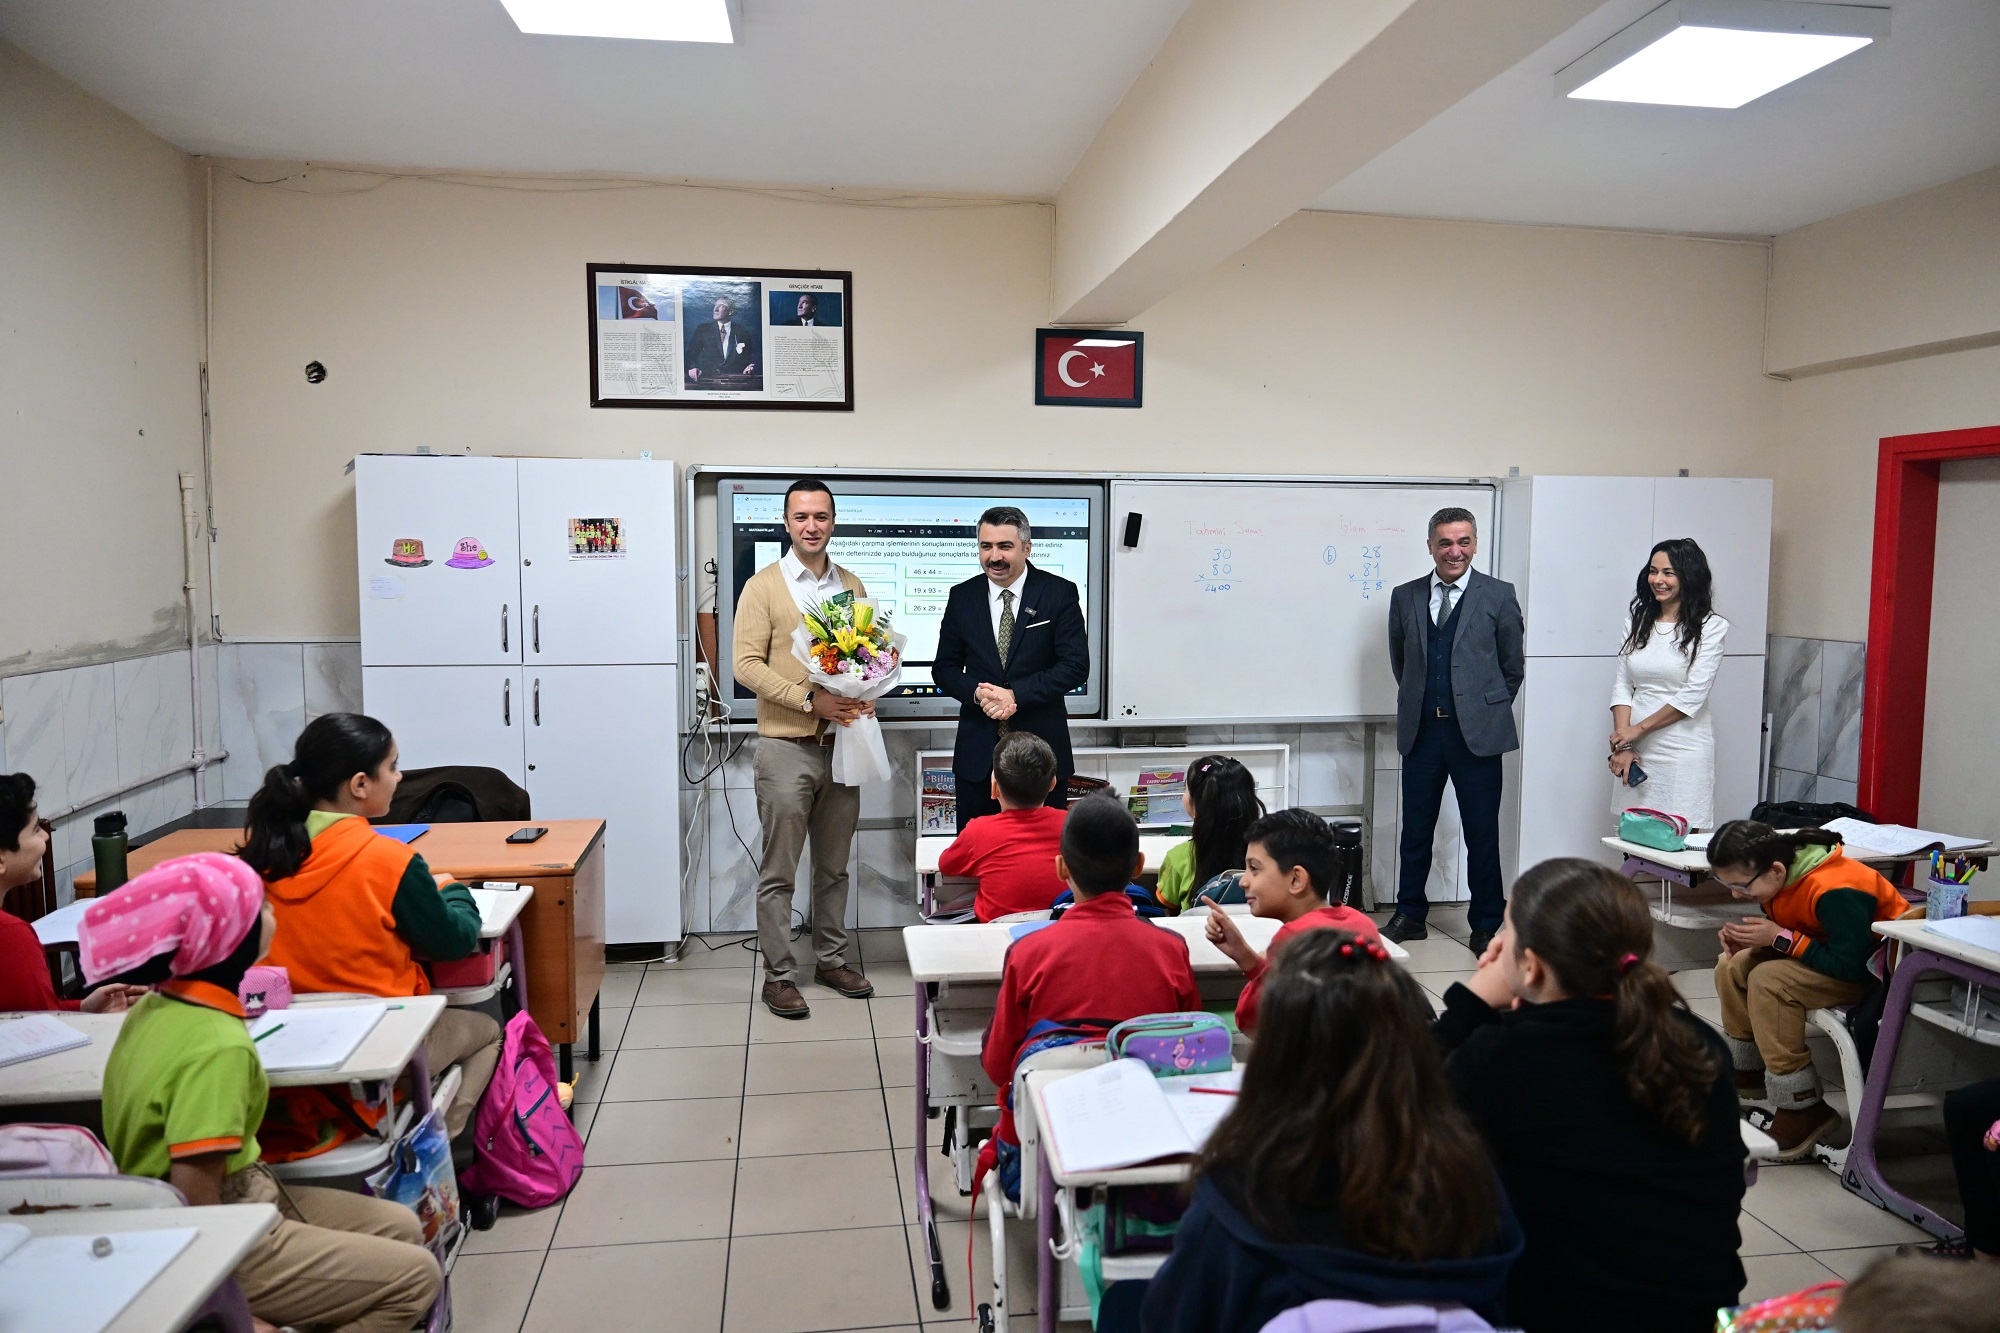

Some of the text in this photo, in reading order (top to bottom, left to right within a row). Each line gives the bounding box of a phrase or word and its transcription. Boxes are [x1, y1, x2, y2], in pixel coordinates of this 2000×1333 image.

[1184, 520, 1226, 536] Tahmini
[402, 542, 416, 554] He
[460, 541, 477, 552] She
[830, 540, 860, 548] Aşağıdaki
[861, 541, 884, 549] çarpma
[886, 540, 920, 548] işlemlerinin
[921, 541, 955, 549] sonuçlarını
[901, 550, 937, 559] bulduğunuz
[938, 551, 969, 559] sonuçlarla
[1212, 548, 1231, 561] 30
[1362, 546, 1381, 559] 28
[1212, 564, 1231, 576] 80
[1363, 562, 1380, 578] 81
[1205, 583, 1231, 593] 2400
[931, 774, 955, 783] Bilim
